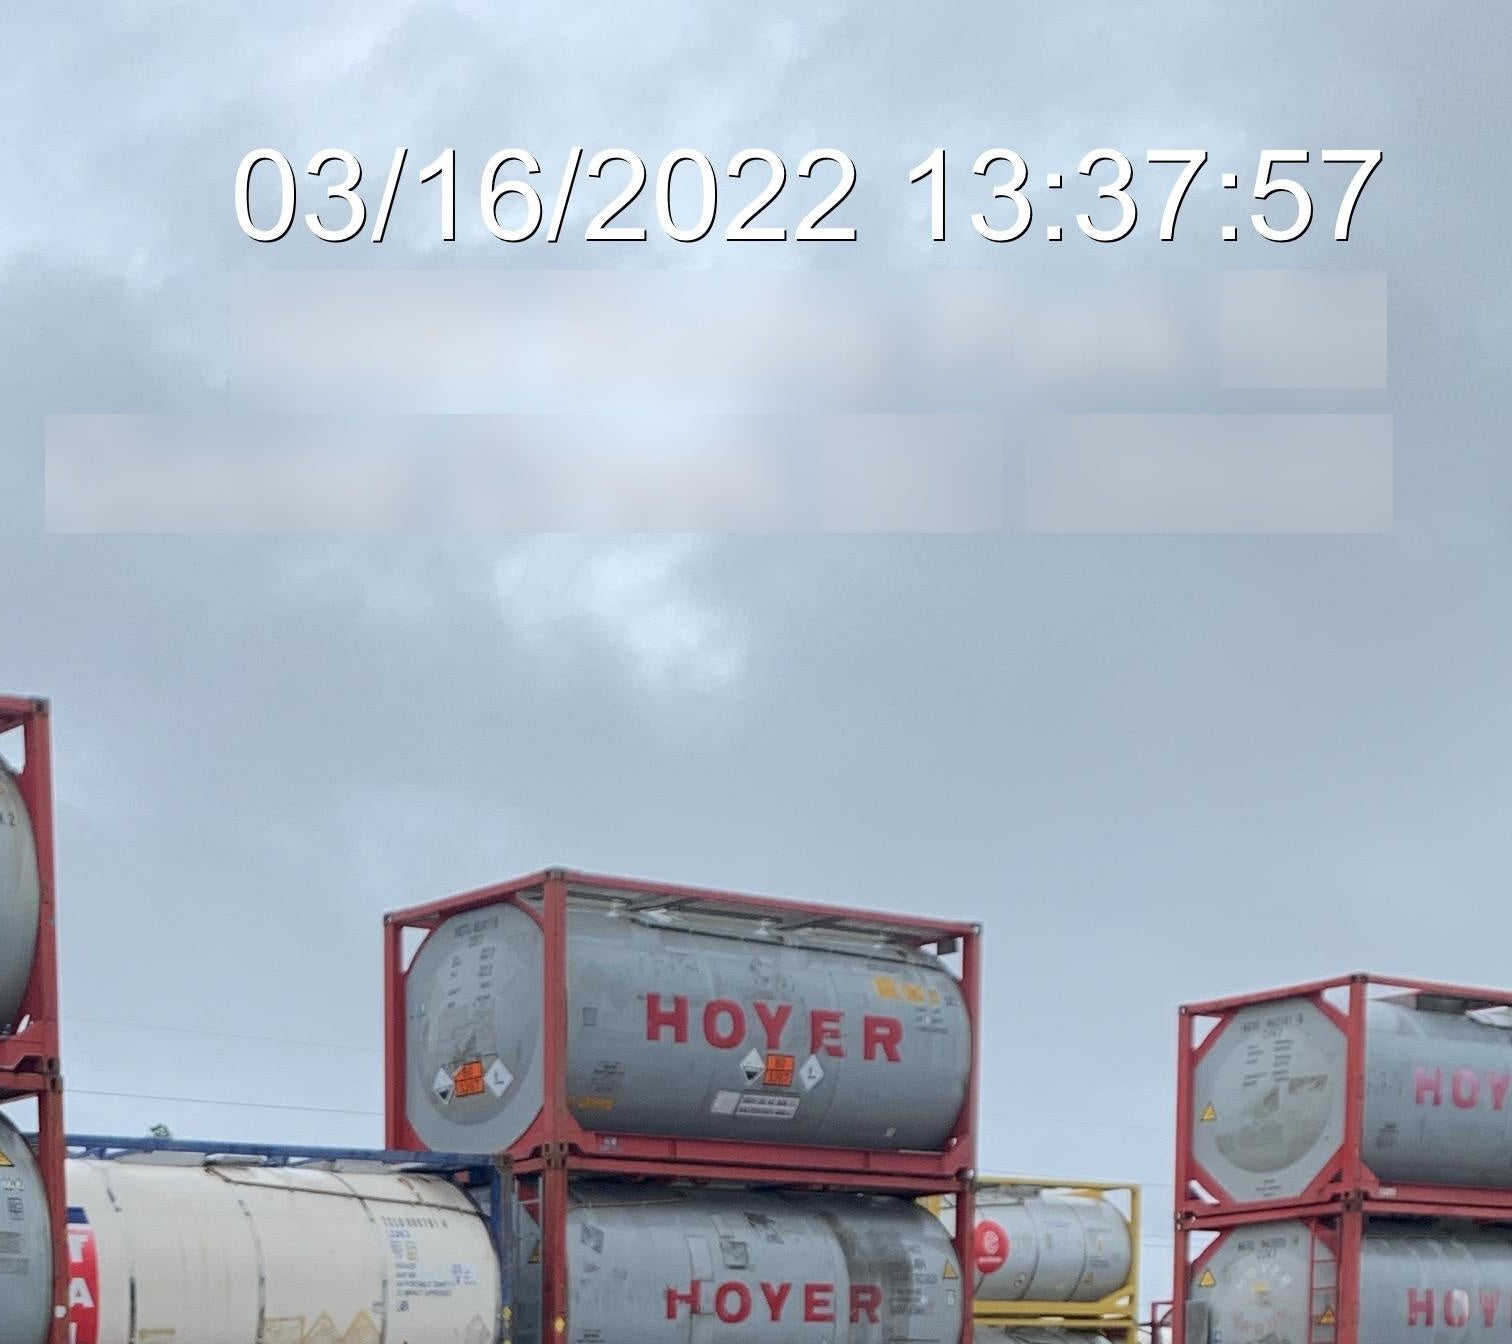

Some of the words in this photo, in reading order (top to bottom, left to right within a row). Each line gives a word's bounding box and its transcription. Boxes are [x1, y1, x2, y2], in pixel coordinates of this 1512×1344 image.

[646, 992, 902, 1064] HOYER
[666, 1279, 884, 1325] HOYER
[1407, 1287, 1512, 1328] HOY
